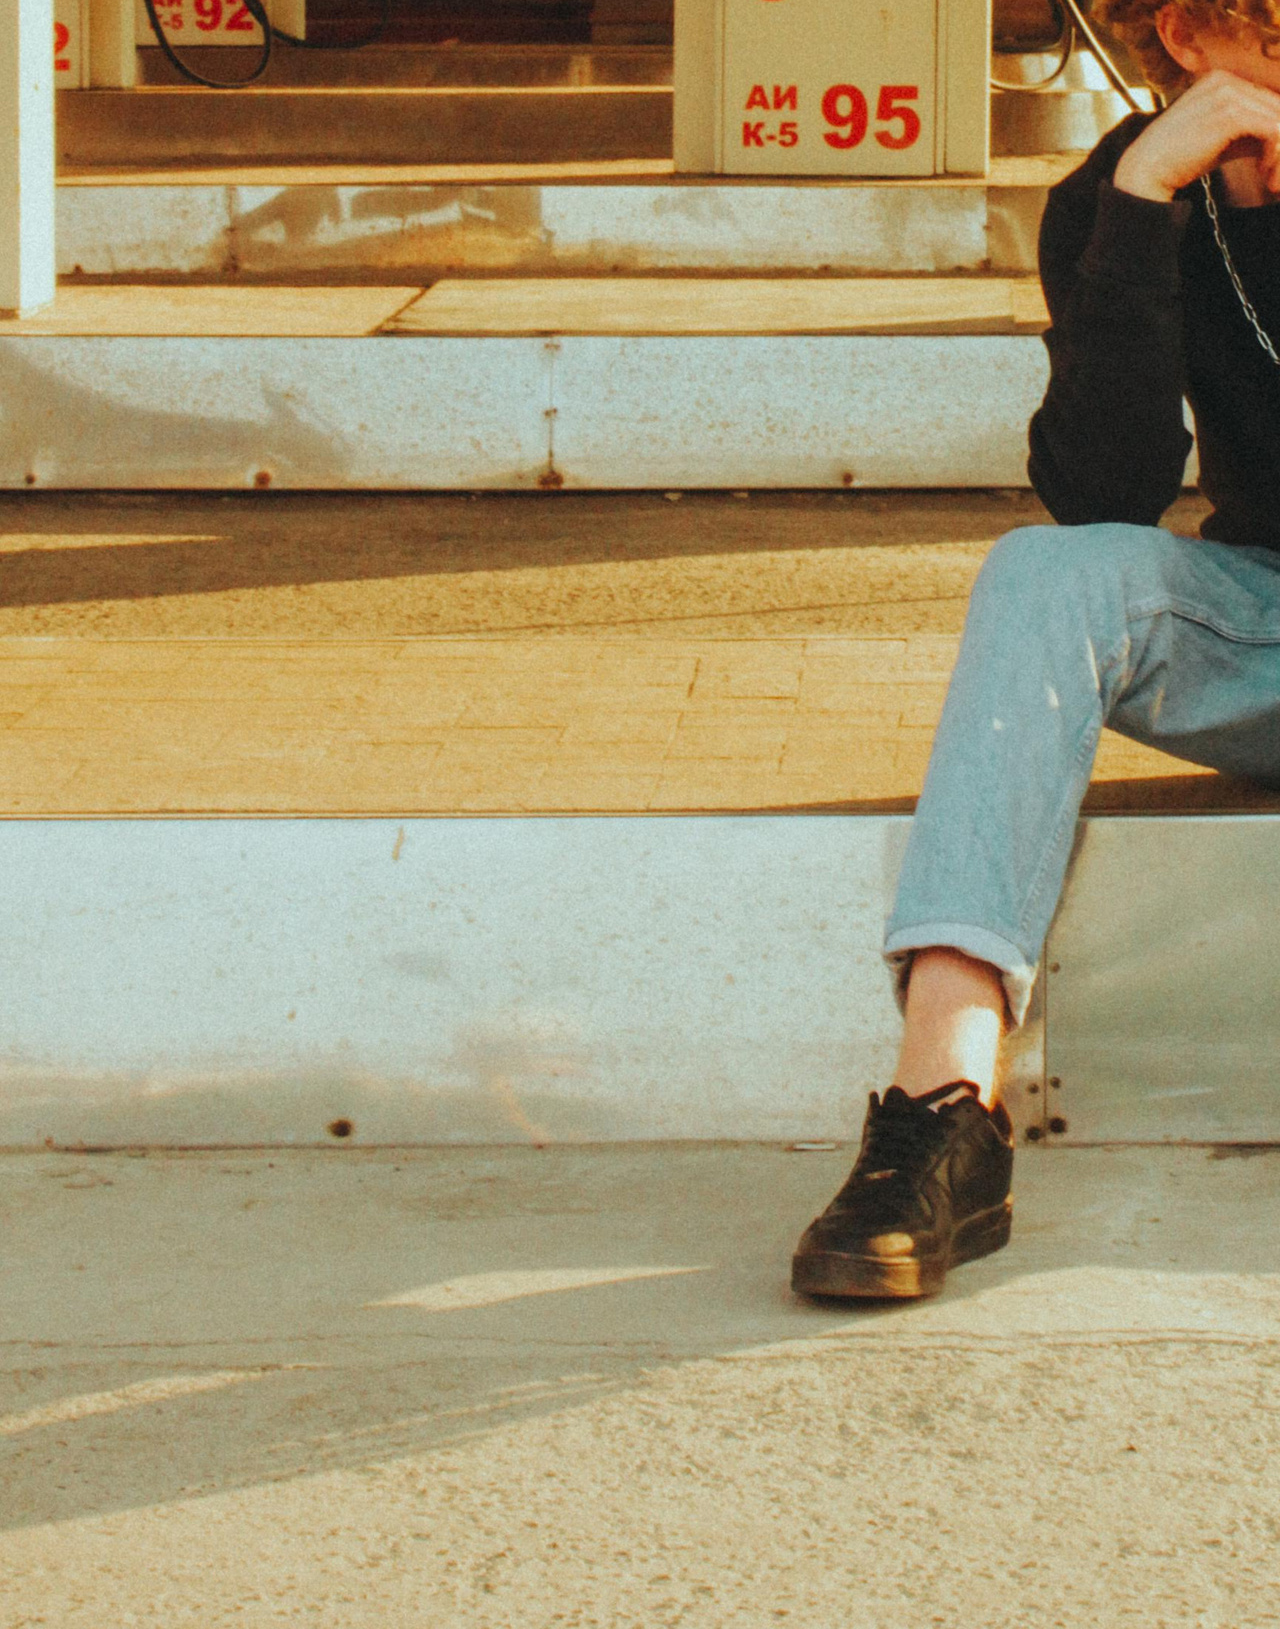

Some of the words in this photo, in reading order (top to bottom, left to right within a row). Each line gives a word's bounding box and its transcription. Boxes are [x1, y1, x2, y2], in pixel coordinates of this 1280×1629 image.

[745, 84, 798, 110] АИ
[820, 83, 922, 150] 95
[742, 122, 799, 147] К-5
